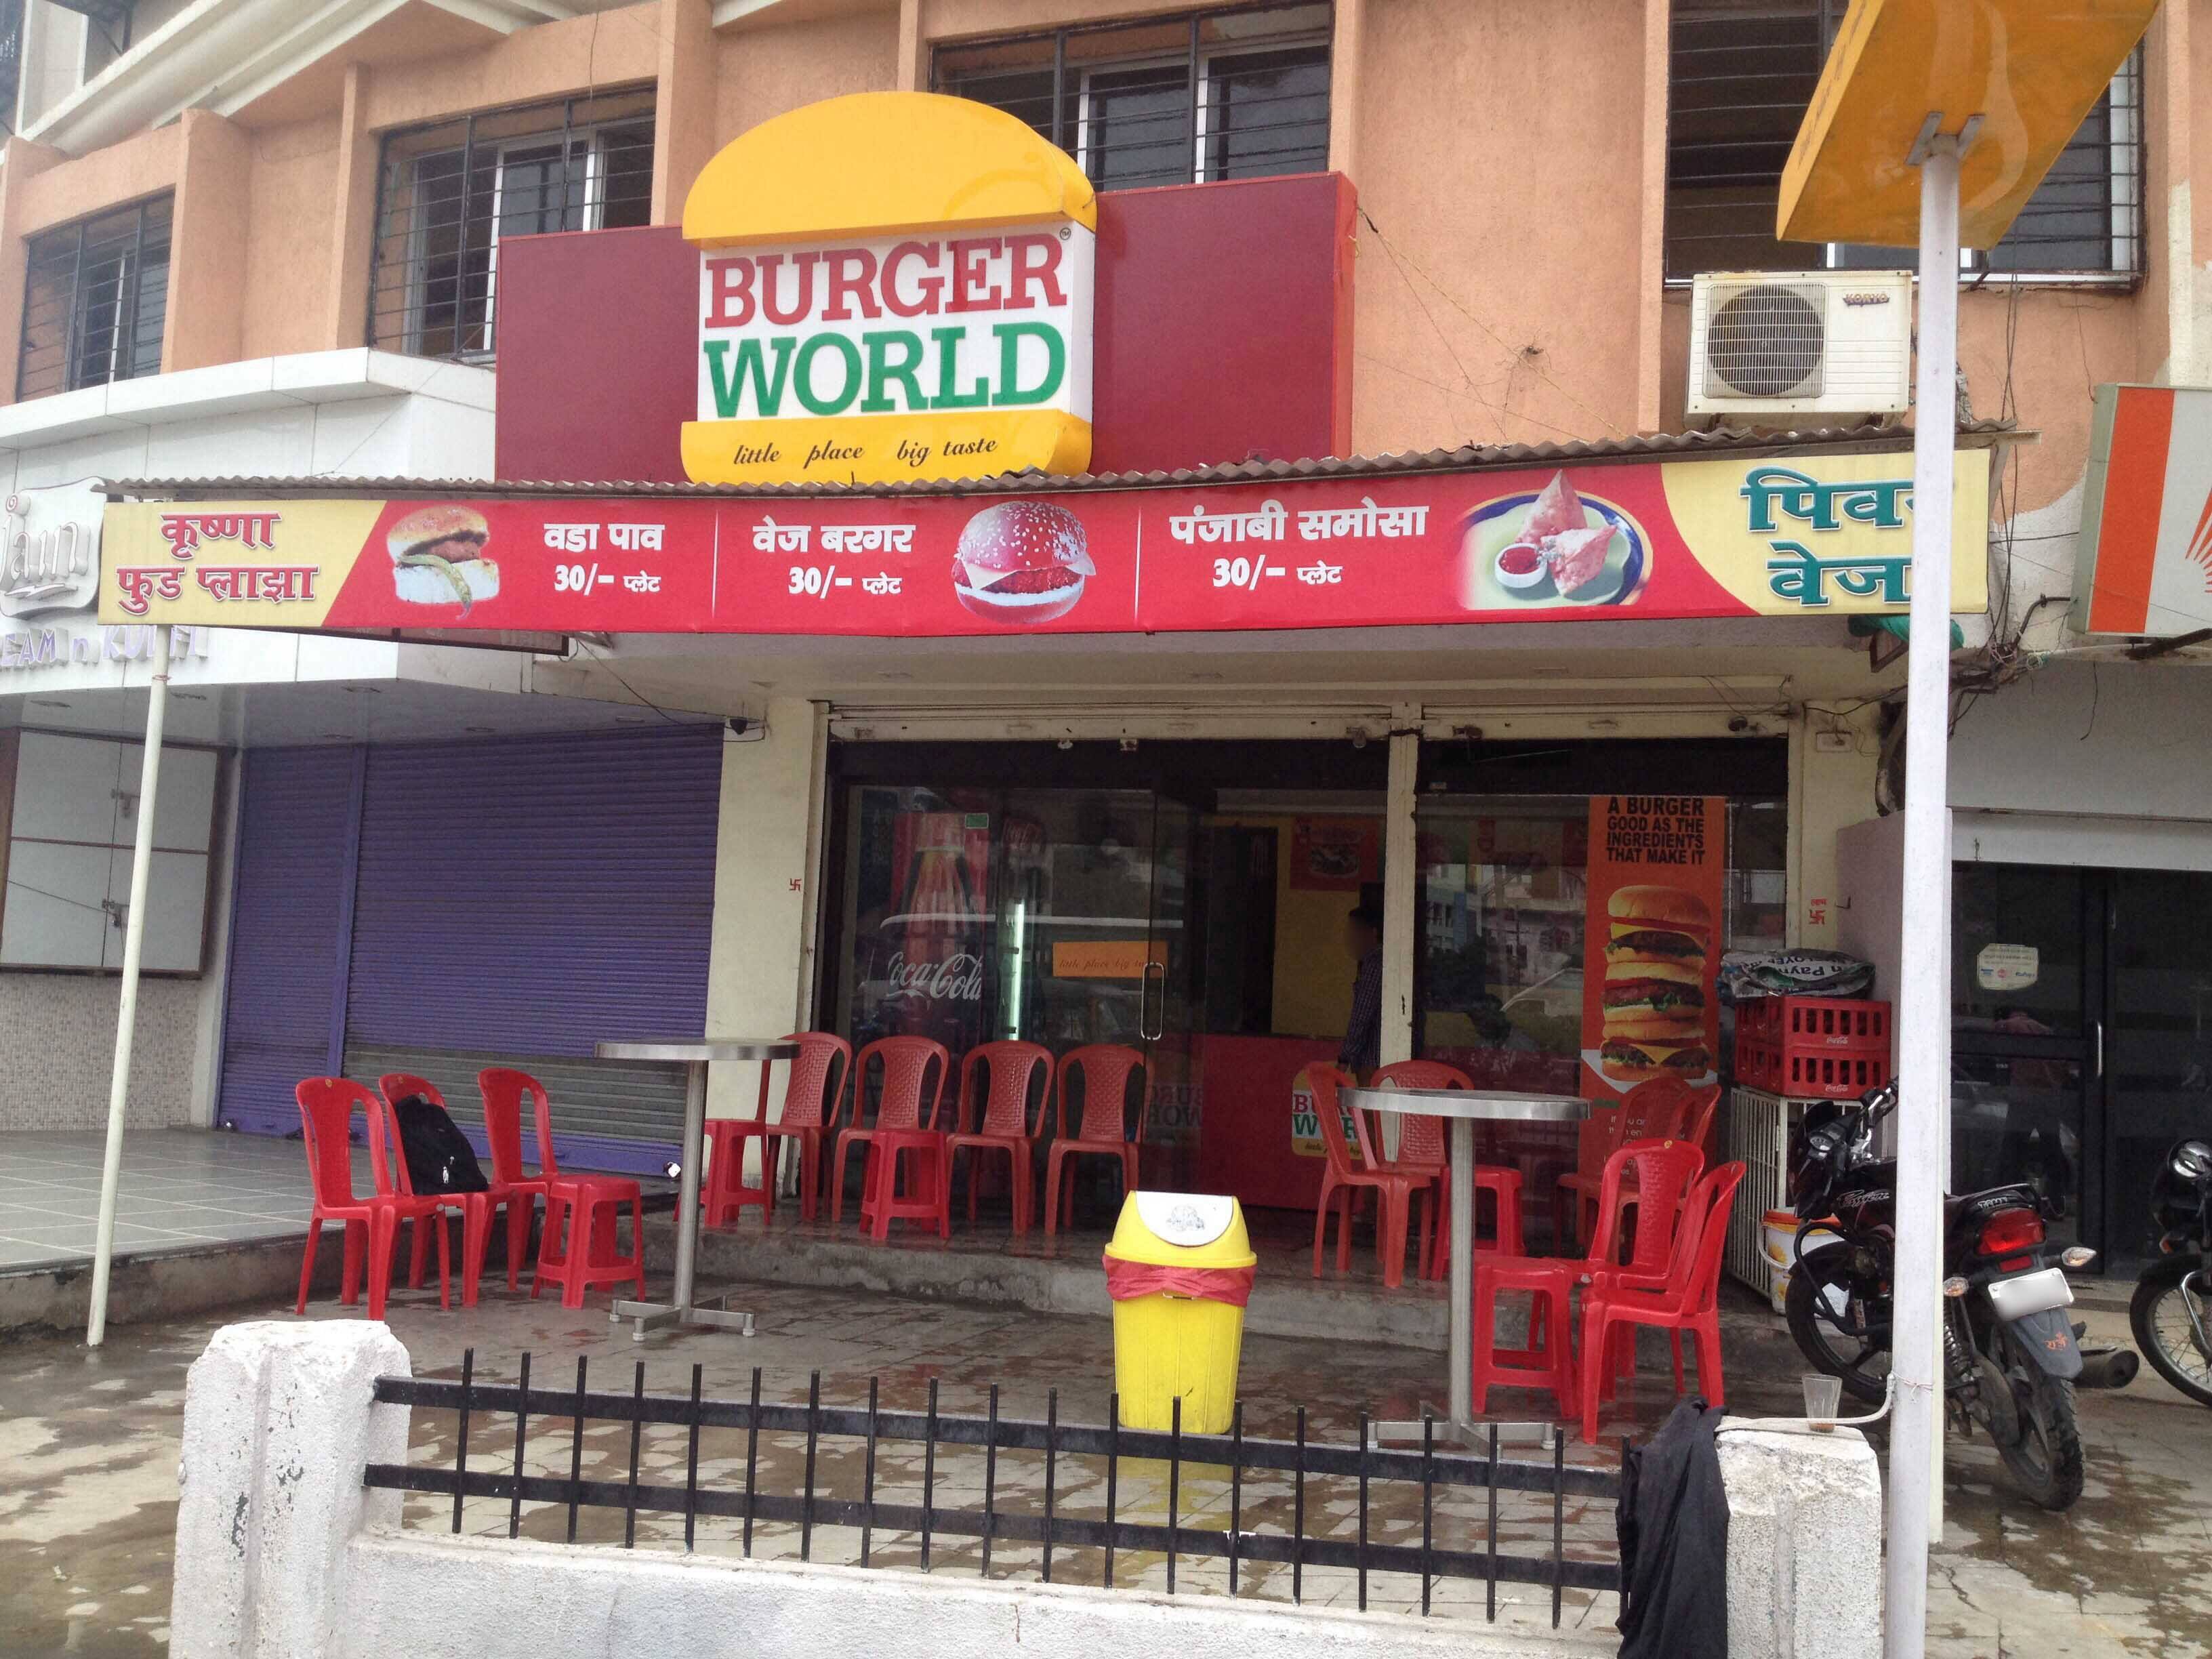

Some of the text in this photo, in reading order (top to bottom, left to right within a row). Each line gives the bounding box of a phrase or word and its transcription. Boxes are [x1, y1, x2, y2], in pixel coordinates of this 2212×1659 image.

[705, 233, 1067, 329] BURGER
[703, 322, 1065, 417] WORLD
[733, 437, 998, 468] little place big taste
[1740, 466, 1914, 532] पिव
[160, 511, 282, 559] कृष्णा
[544, 523, 665, 552] वडा पाव
[752, 515, 916, 553] वेज बरगर
[1169, 496, 1430, 544] पंजाबी समोसा
[116, 565, 320, 615] फुड प्लाझा
[554, 563, 661, 596] 30/- प्लेट
[788, 565, 902, 598] 30/- प्लेट
[1212, 554, 1343, 591] 30/- प्लेट
[1607, 797, 1704, 816] A BURGER
[1607, 816, 1704, 833] GOOD AS THE
[1607, 832, 1704, 848] INGREDIENTS
[1607, 848, 1705, 865] THAT MAKE IT
